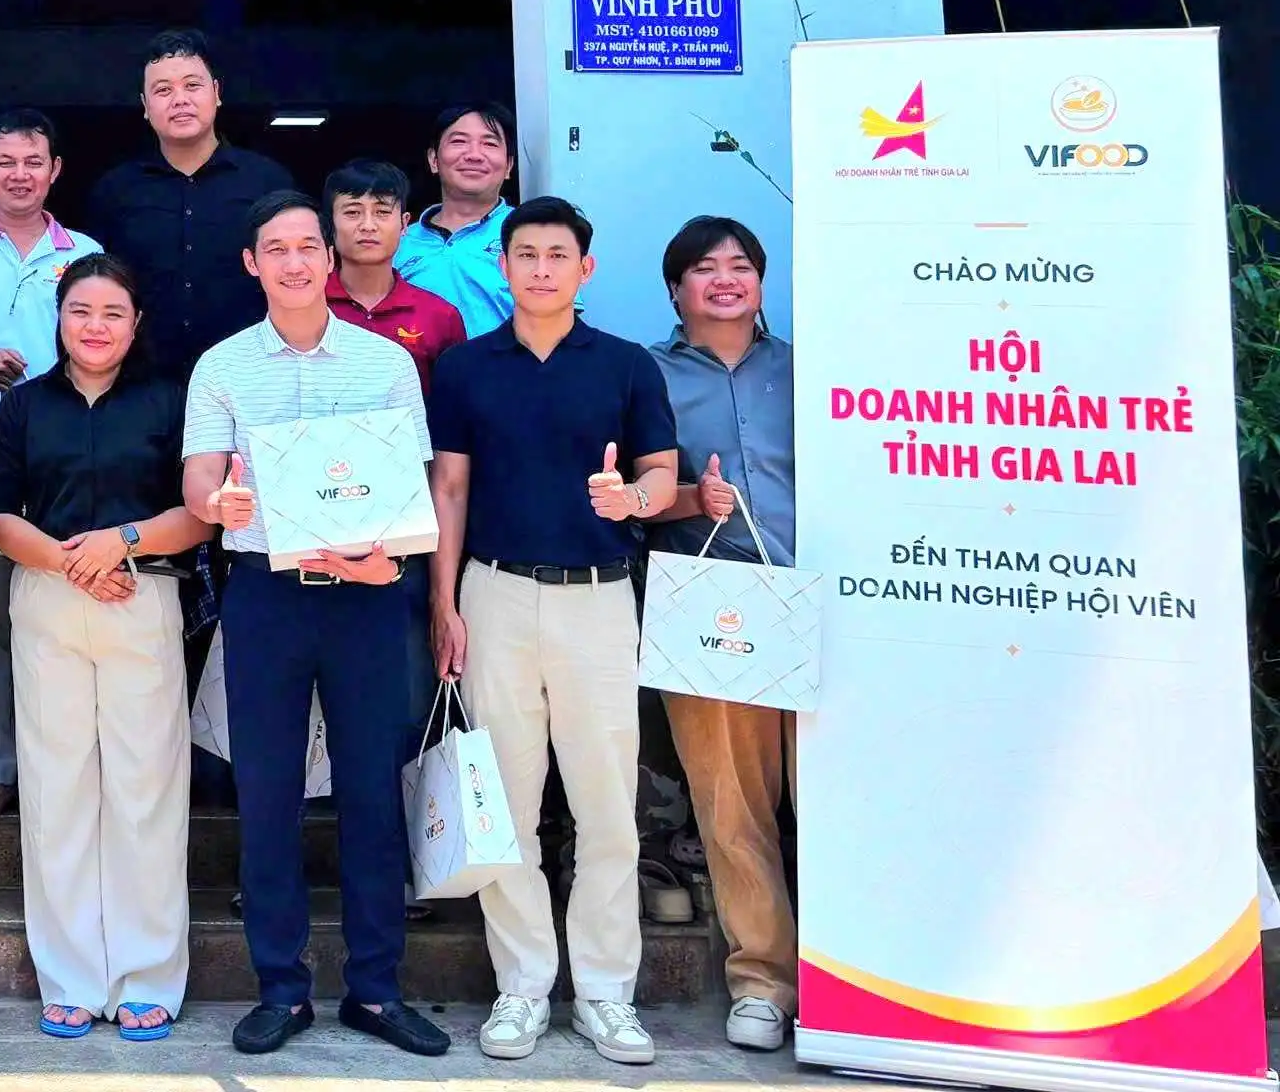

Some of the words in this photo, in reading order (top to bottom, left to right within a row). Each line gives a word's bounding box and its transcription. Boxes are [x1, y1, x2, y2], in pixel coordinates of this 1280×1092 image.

[596, 24, 634, 36] MST:
[638, 25, 719, 37] 4101661099
[584, 42, 607, 51] 397A
[672, 43, 682, 52] P.
[595, 56, 610, 65] TP.
[613, 57, 630, 66] QUY
[664, 57, 672, 66] T.
[1024, 144, 1148, 167] VIFOOD
[851, 169, 878, 177] DOANH
[957, 168, 969, 176] LAI
[912, 256, 996, 282] CHÀO
[1006, 257, 1095, 283] MỪNG
[969, 330, 1041, 382] HỘI
[831, 387, 973, 424] DOANH
[986, 385, 1108, 429] NHÂN
[1120, 386, 1193, 432] TRẺ
[882, 430, 978, 478] TỈNH
[991, 446, 1064, 482] GIA
[1074, 450, 1137, 486] LAI
[316, 485, 370, 500] VIFOOD
[891, 536, 947, 567] ĐẾN
[955, 547, 1040, 572] THAM
[1049, 554, 1136, 578] QUAN
[839, 576, 942, 602] DOANH
[951, 581, 1057, 614] NGHIỆP
[1067, 586, 1118, 618] HỘI
[1128, 591, 1196, 619] VIÊN
[699, 635, 754, 653] VIFOOD
